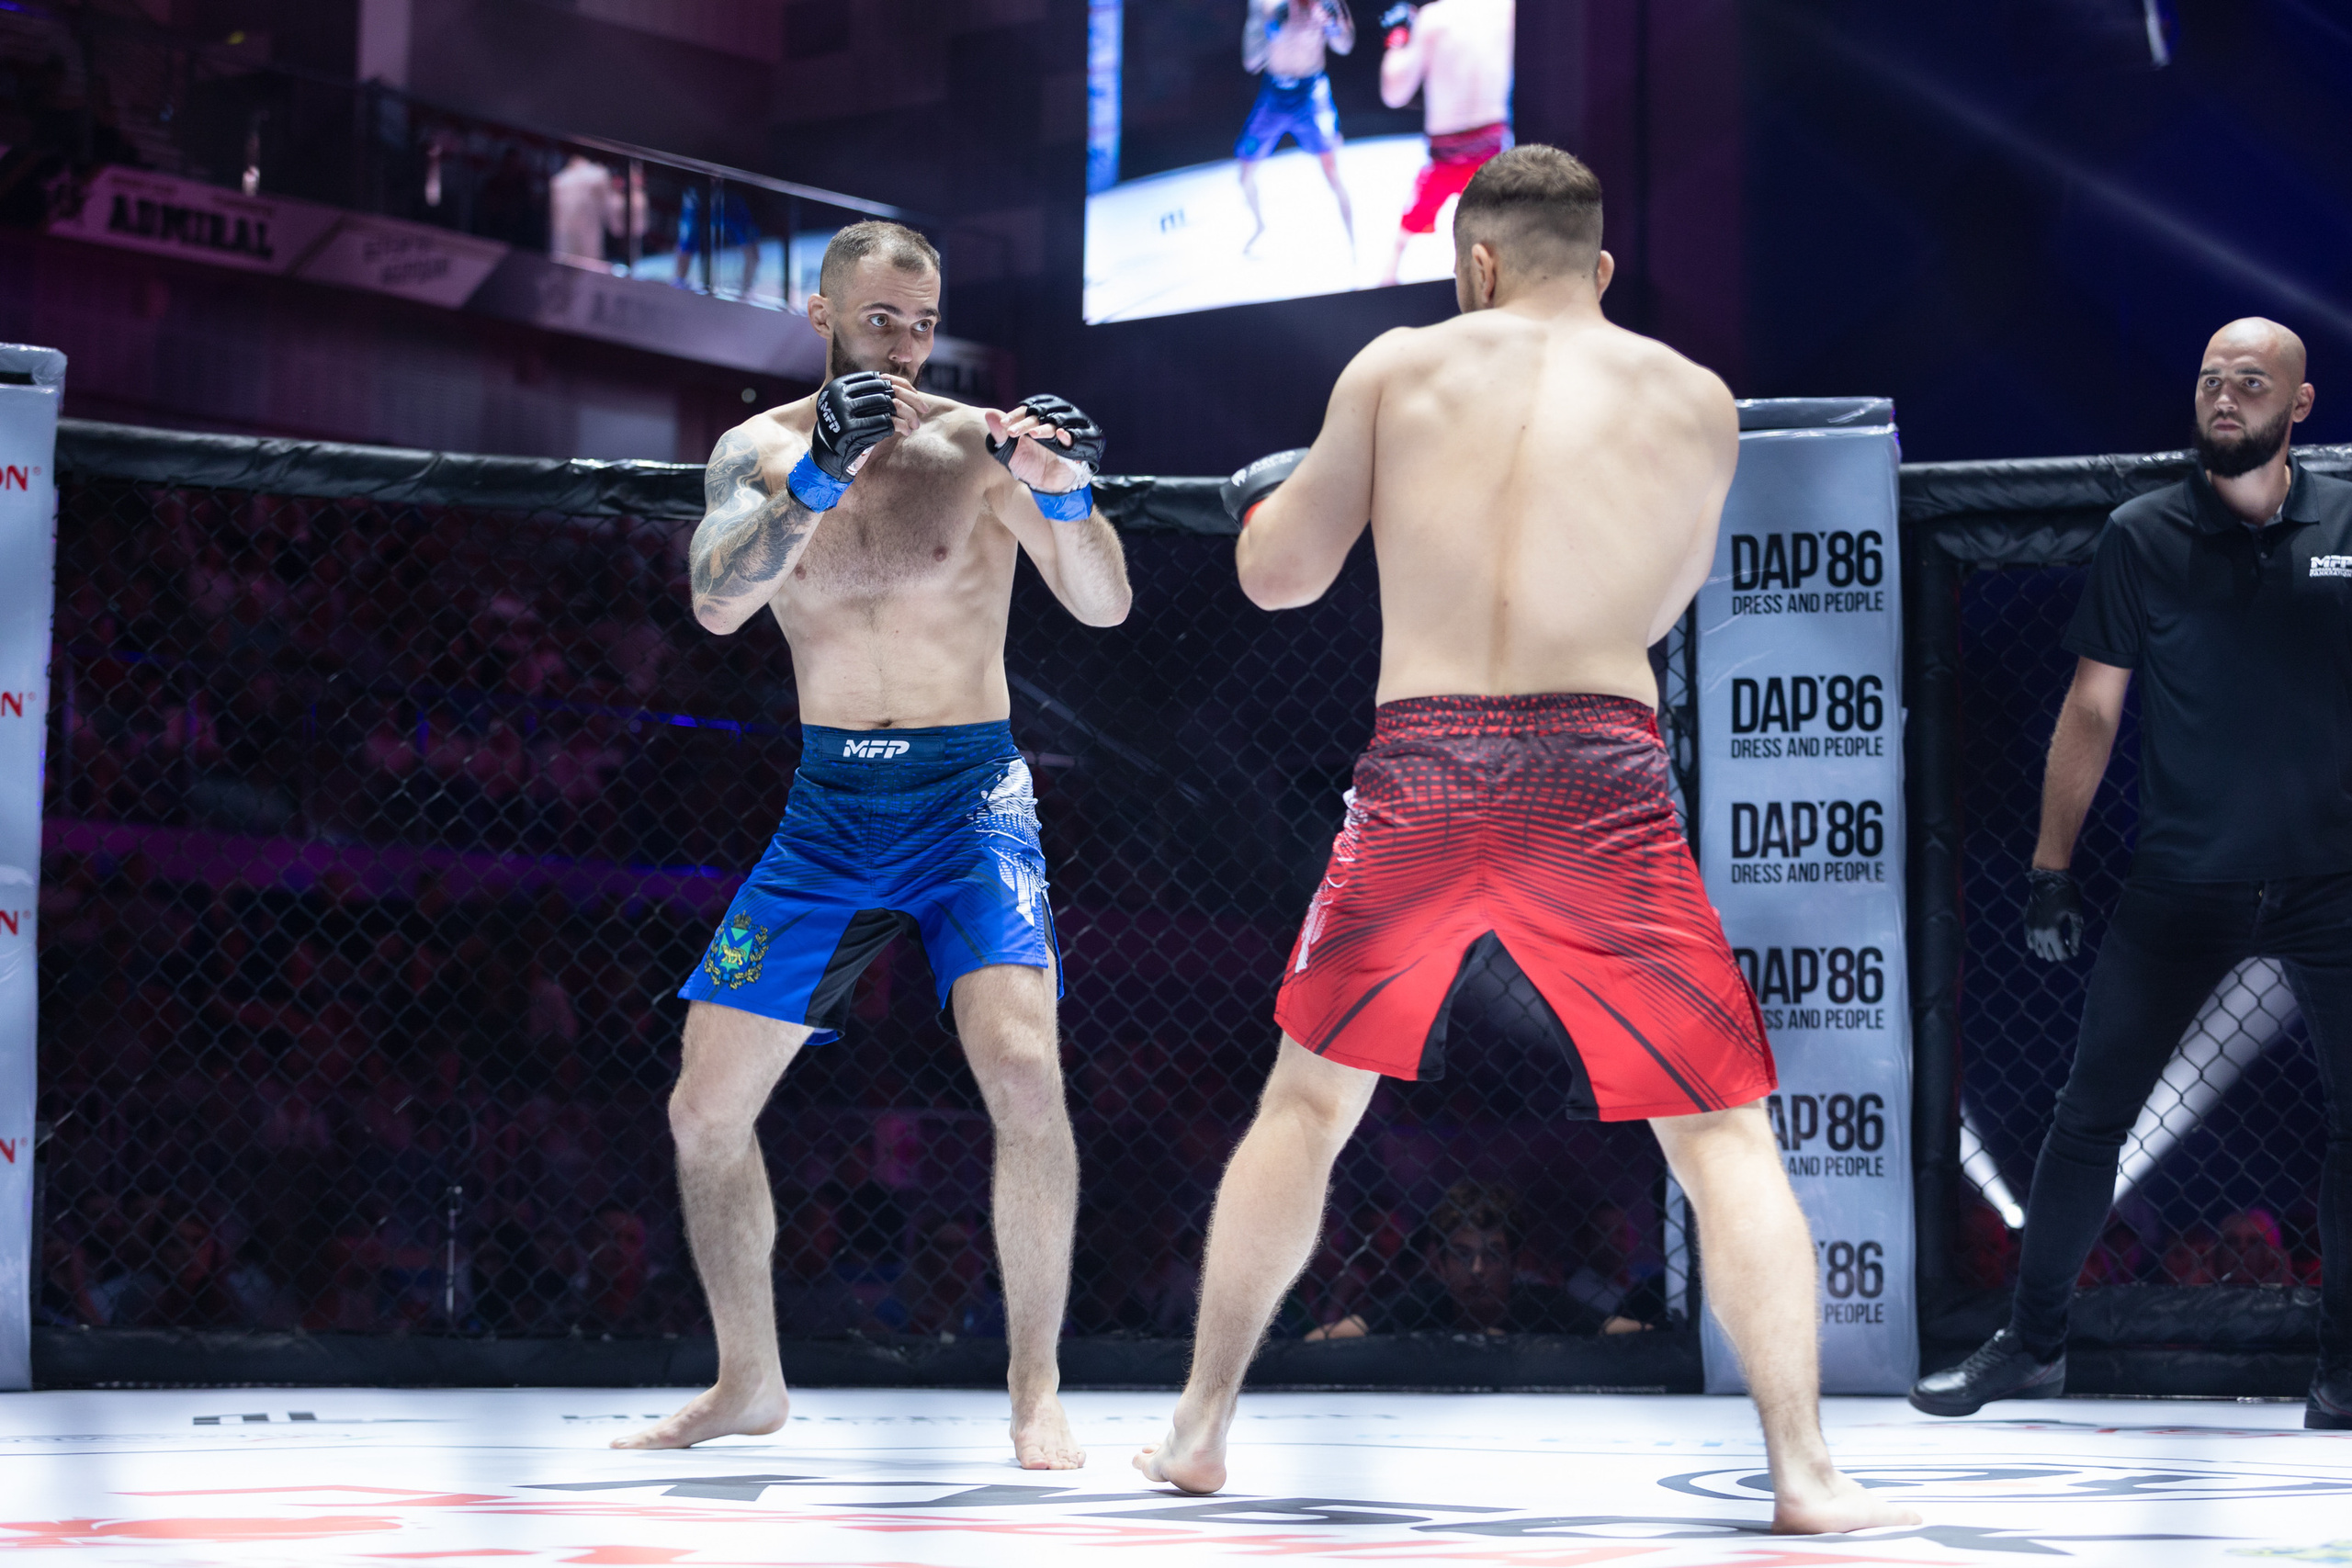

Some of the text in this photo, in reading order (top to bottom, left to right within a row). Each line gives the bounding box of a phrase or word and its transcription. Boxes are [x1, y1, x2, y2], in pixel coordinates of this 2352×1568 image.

[820, 400, 841, 434] MFP
[1732, 591, 1883, 616] DRESS AND PEOPLE
[842, 739, 910, 759] MFP
[1732, 737, 1883, 759] DRESS AND PEOPLE
[1732, 862, 1884, 884] DRESS AND PEOPLE
[1788, 1009, 1820, 1030] AND
[1825, 1009, 1883, 1030] PEOPLE
[1767, 1093, 1884, 1153] AP'86
[1788, 1156, 1883, 1177] AND PEOPLE
[1825, 1303, 1883, 1324] PEOPLE
